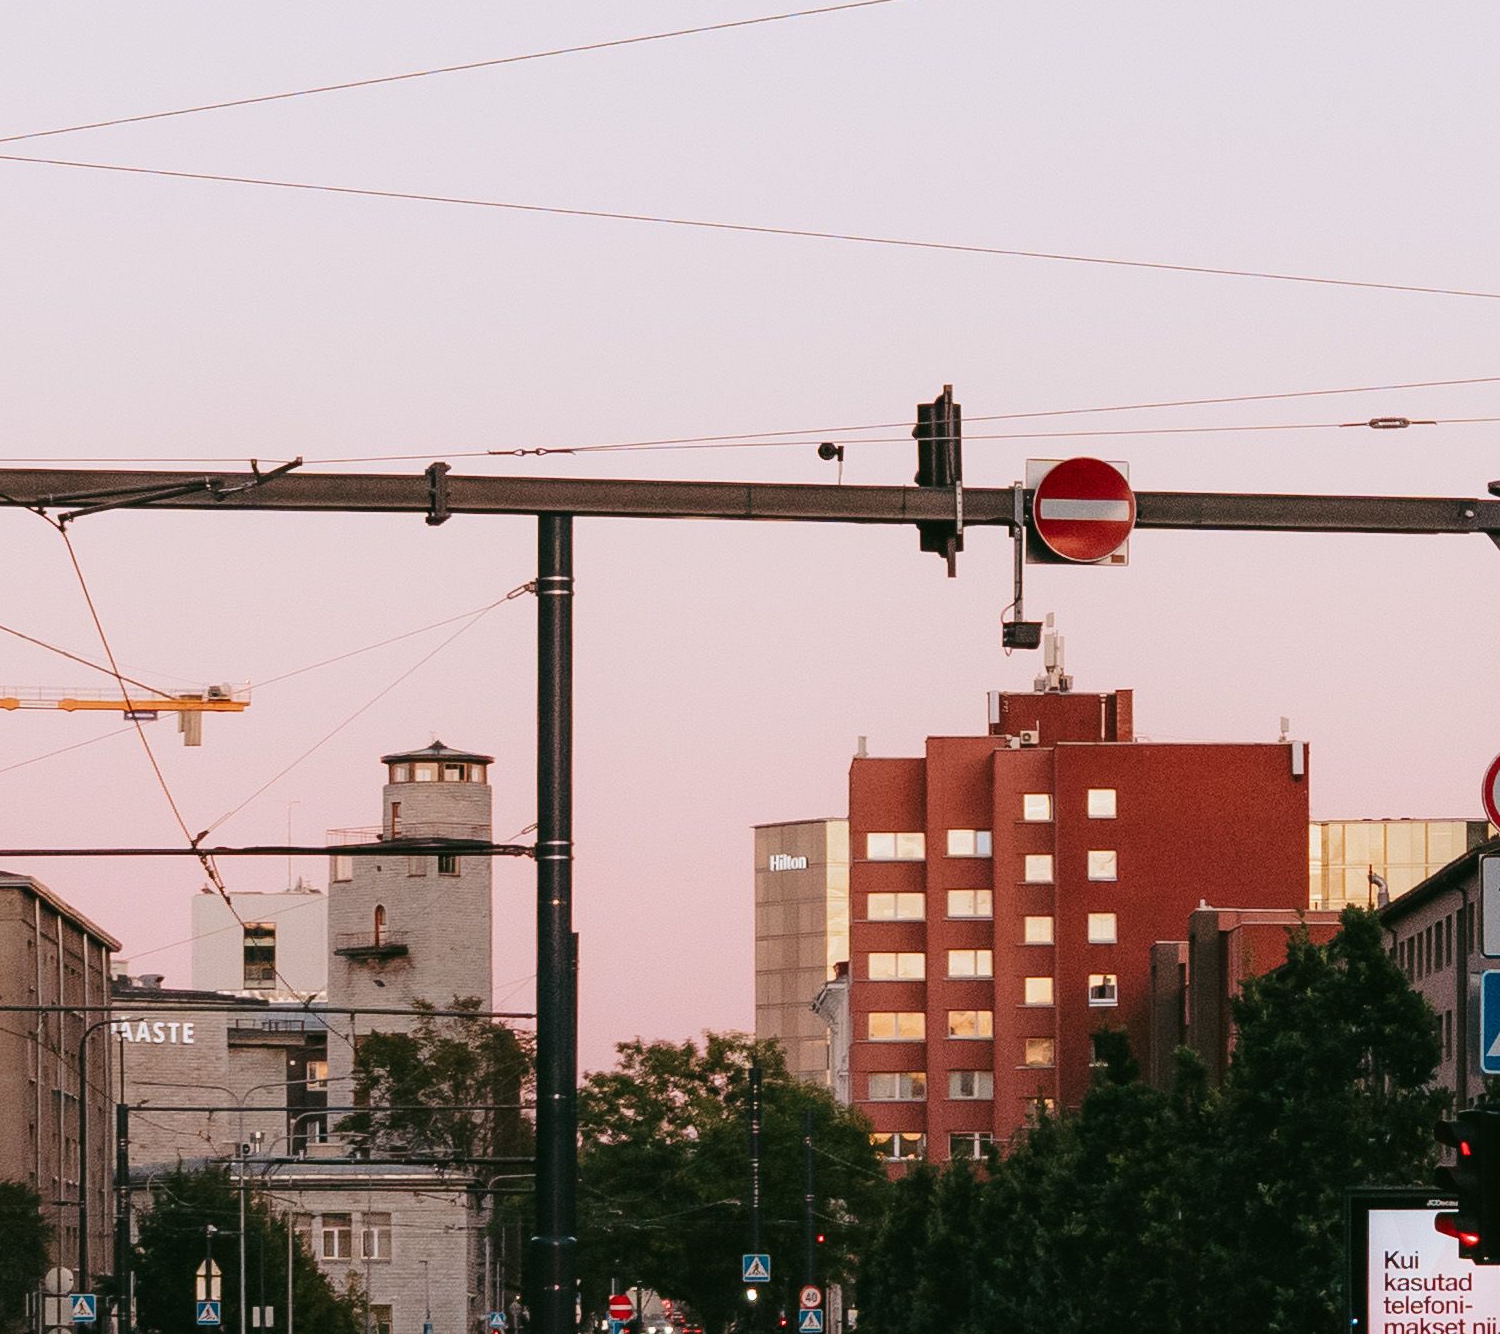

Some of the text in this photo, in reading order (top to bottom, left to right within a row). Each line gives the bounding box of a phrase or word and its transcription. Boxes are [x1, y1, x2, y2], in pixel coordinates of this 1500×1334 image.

[770, 854, 807, 872] Hilton
[1384, 1250, 1419, 1270] Kui
[1384, 1273, 1473, 1292] kasutad
[1384, 1295, 1474, 1315] telefoni-
